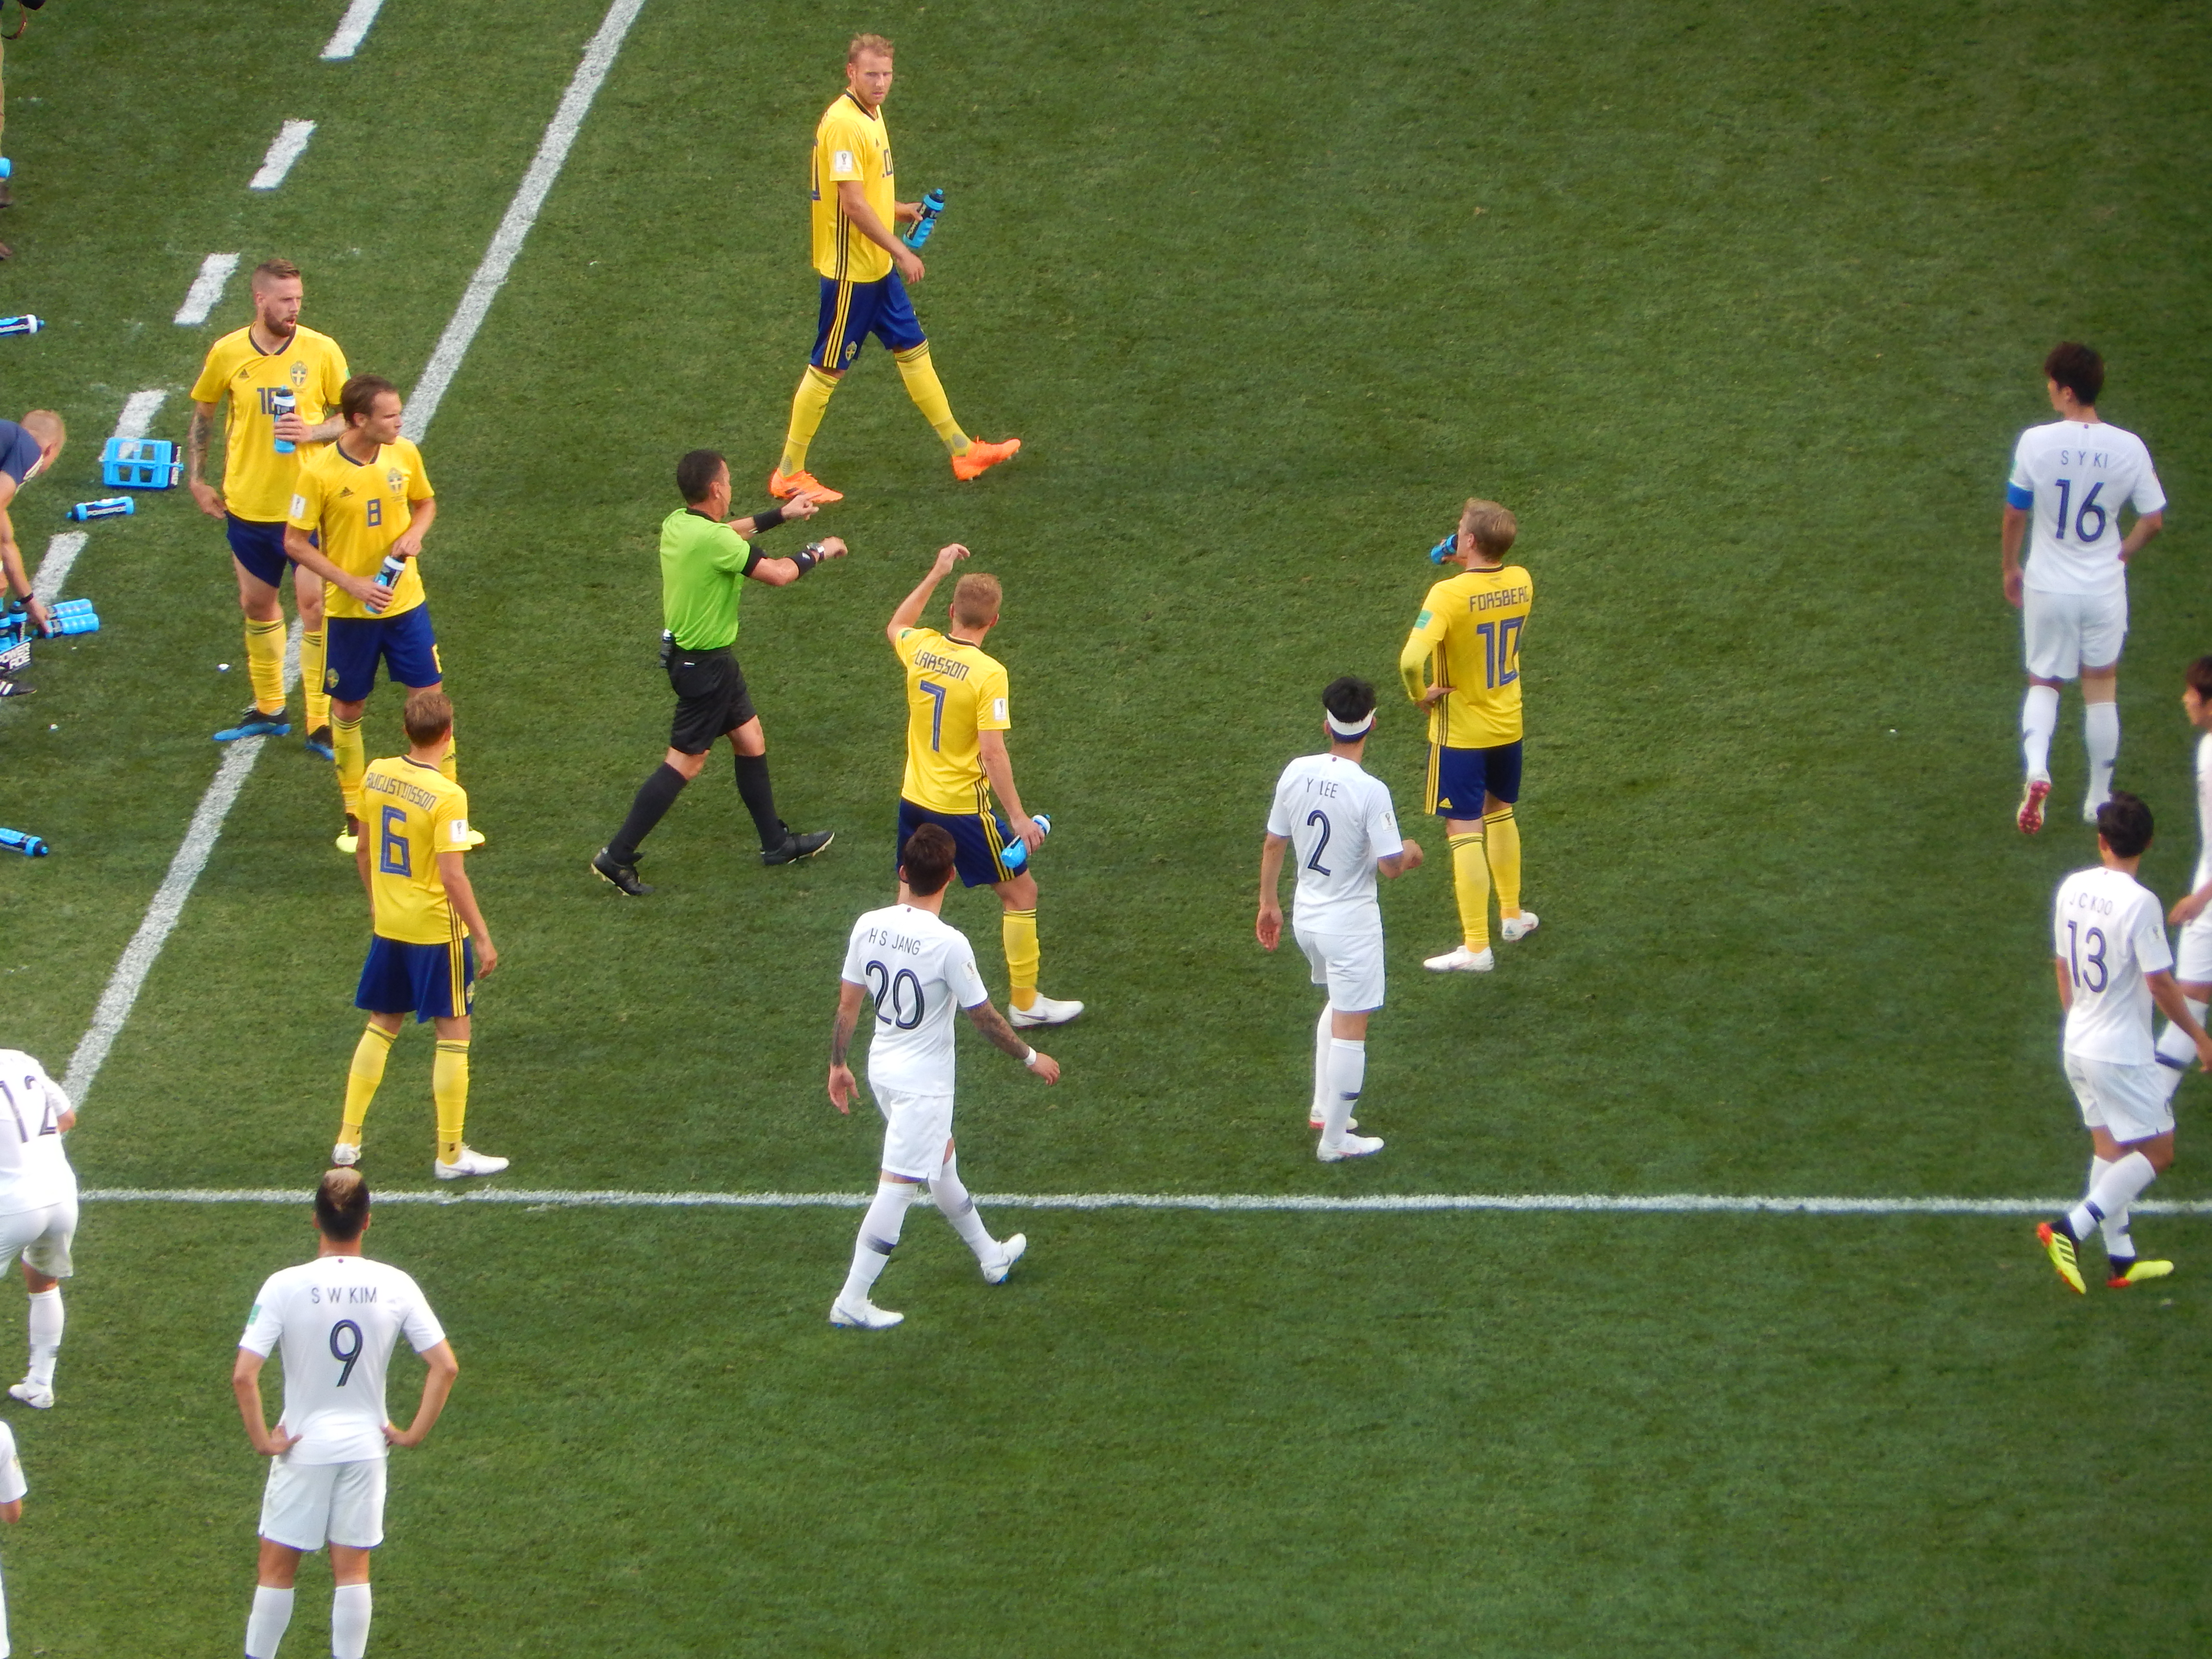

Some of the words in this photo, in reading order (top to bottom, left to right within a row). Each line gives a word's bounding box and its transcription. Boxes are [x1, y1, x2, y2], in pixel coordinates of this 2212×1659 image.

[2061, 450, 2069, 465] S
[2079, 450, 2086, 466] Y
[2093, 452, 2108, 469] KI
[367, 498, 382, 527] 8
[2055, 478, 2106, 542] 16
[914, 649, 970, 681] LARSSON
[1476, 614, 1527, 689] 10
[920, 679, 947, 753] 7
[1307, 777, 1314, 793] Y
[1320, 780, 1339, 799] LEE
[380, 805, 412, 878] 6
[1307, 809, 1331, 877] 2
[2079, 892, 2088, 908] C
[868, 927, 878, 944] H
[879, 930, 888, 946] S
[891, 934, 921, 955] JANG
[2067, 919, 2108, 993] 13
[866, 960, 925, 1030] 20
[312, 1287, 321, 1304] S
[327, 1287, 342, 1304] W
[349, 1286, 377, 1304] KIM
[329, 1319, 363, 1387] 9
